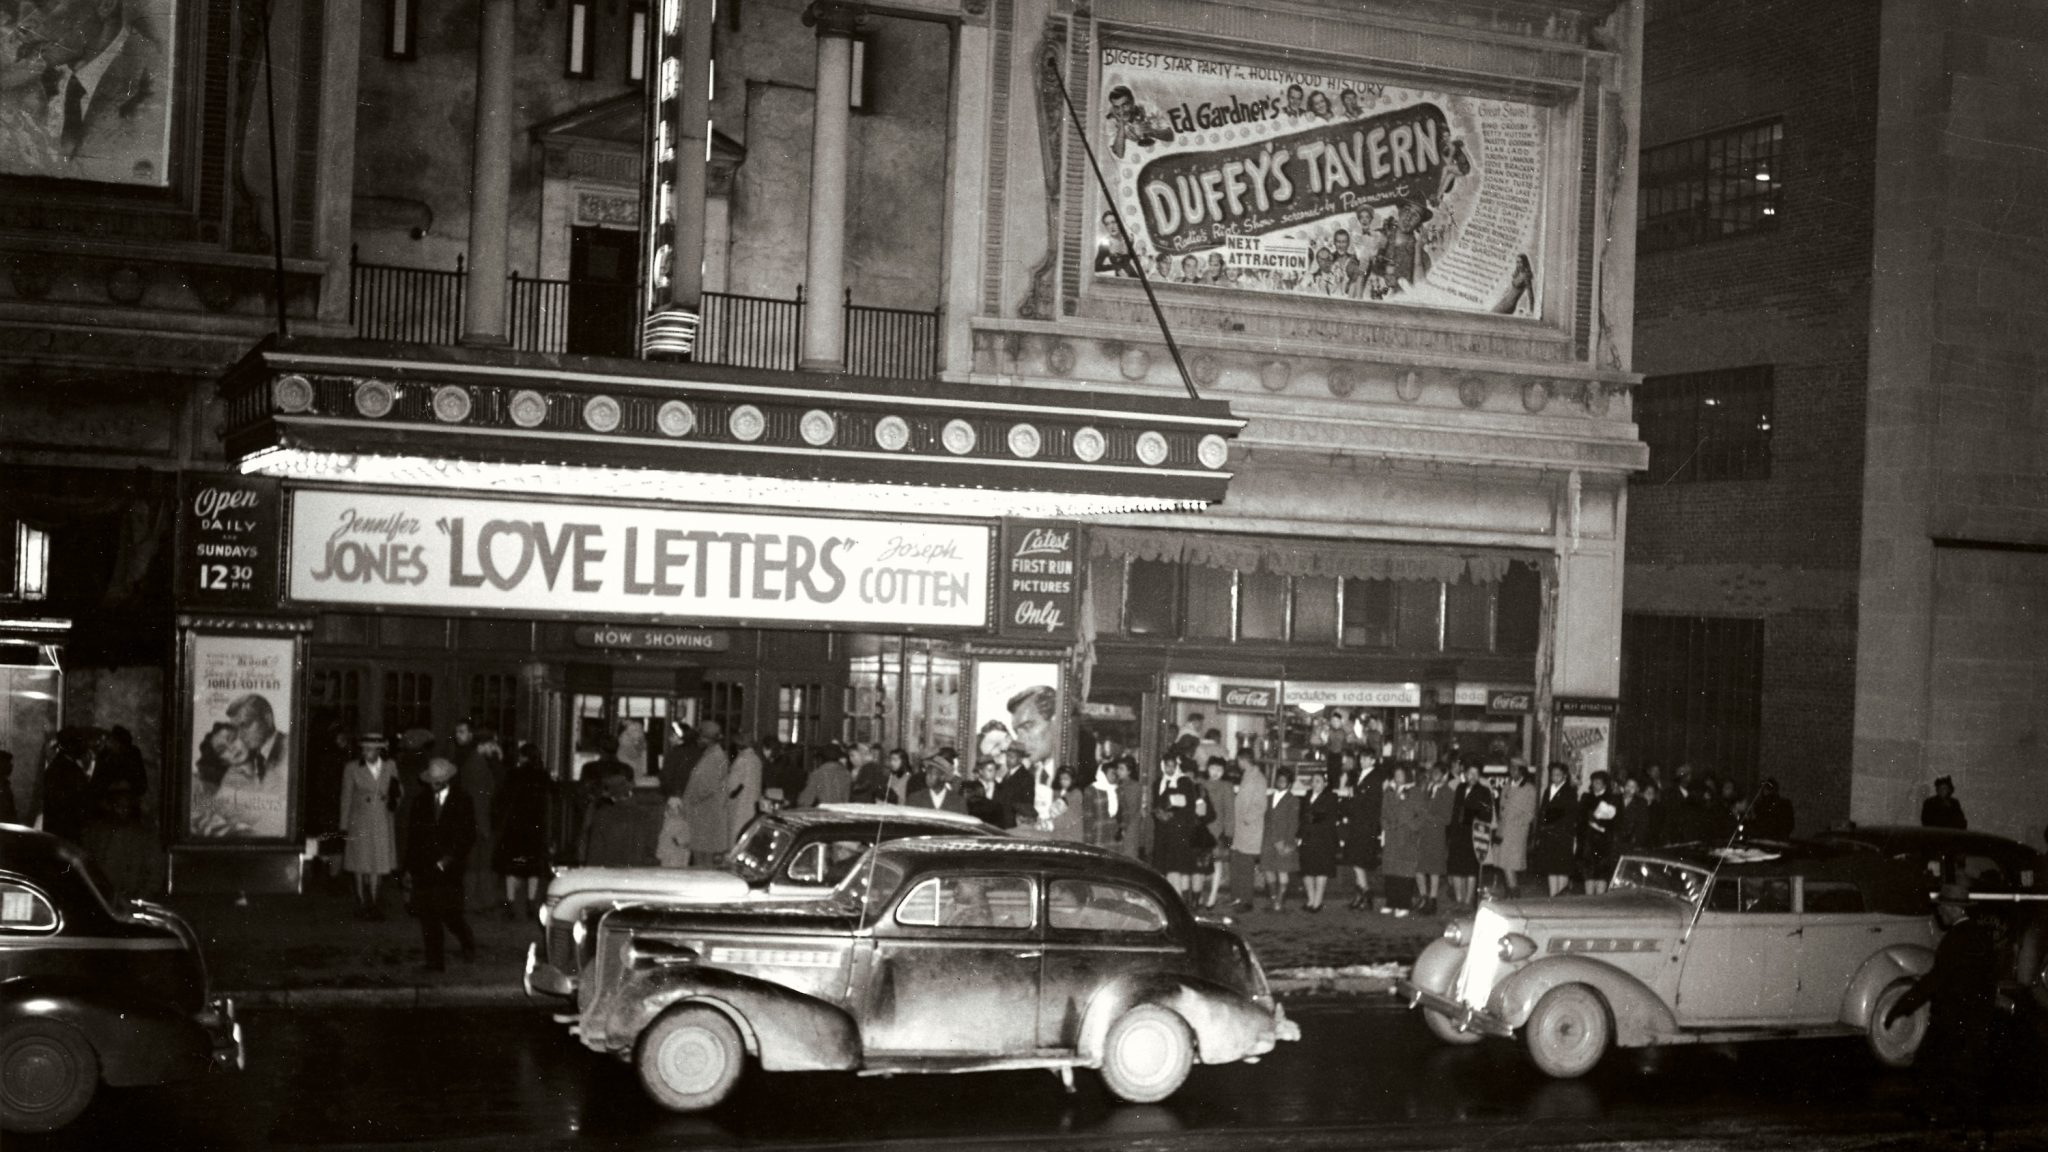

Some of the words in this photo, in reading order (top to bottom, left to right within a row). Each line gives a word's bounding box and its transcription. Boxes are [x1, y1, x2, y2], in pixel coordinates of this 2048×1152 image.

[1103, 50, 1159, 68] BIGGEST
[1163, 55, 1194, 72] STAR
[1197, 59, 1231, 79] PARTY
[1234, 65, 1246, 80] in
[1248, 66, 1321, 87] HOLLYWOOD
[1327, 75, 1385, 96] HISTORY
[1167, 103, 1197, 133] Ed
[1197, 94, 1281, 130] Gardner's
[1145, 142, 1293, 236] DUFFY'S
[1297, 119, 1440, 193] TAVERN
[1173, 230, 1207, 251] Radio's
[1212, 221, 1239, 239] Riot
[1227, 236, 1261, 250] NEXT
[1228, 252, 1306, 268] ATTRACTION
[194, 487, 259, 520] Open
[201, 519, 257, 531] DAILY
[331, 508, 421, 542] Jennifer
[197, 543, 258, 558] SUNDAYS
[877, 535, 964, 562] Joseph
[1015, 528, 1070, 556] Latest
[310, 540, 429, 587] JONES
[1012, 558, 1046, 573] FIRST
[1048, 560, 1073, 574] RUN
[859, 566, 971, 608] COTTEN
[1012, 579, 1070, 593] PICTURES
[1014, 600, 1064, 632] Only
[594, 630, 632, 646] NOW
[645, 632, 713, 649] SHOWING
[1176, 682, 1211, 696] lunch
[1286, 690, 1338, 701] sandwiches
[1343, 690, 1372, 702] soda
[1376, 690, 1413, 703] candy
